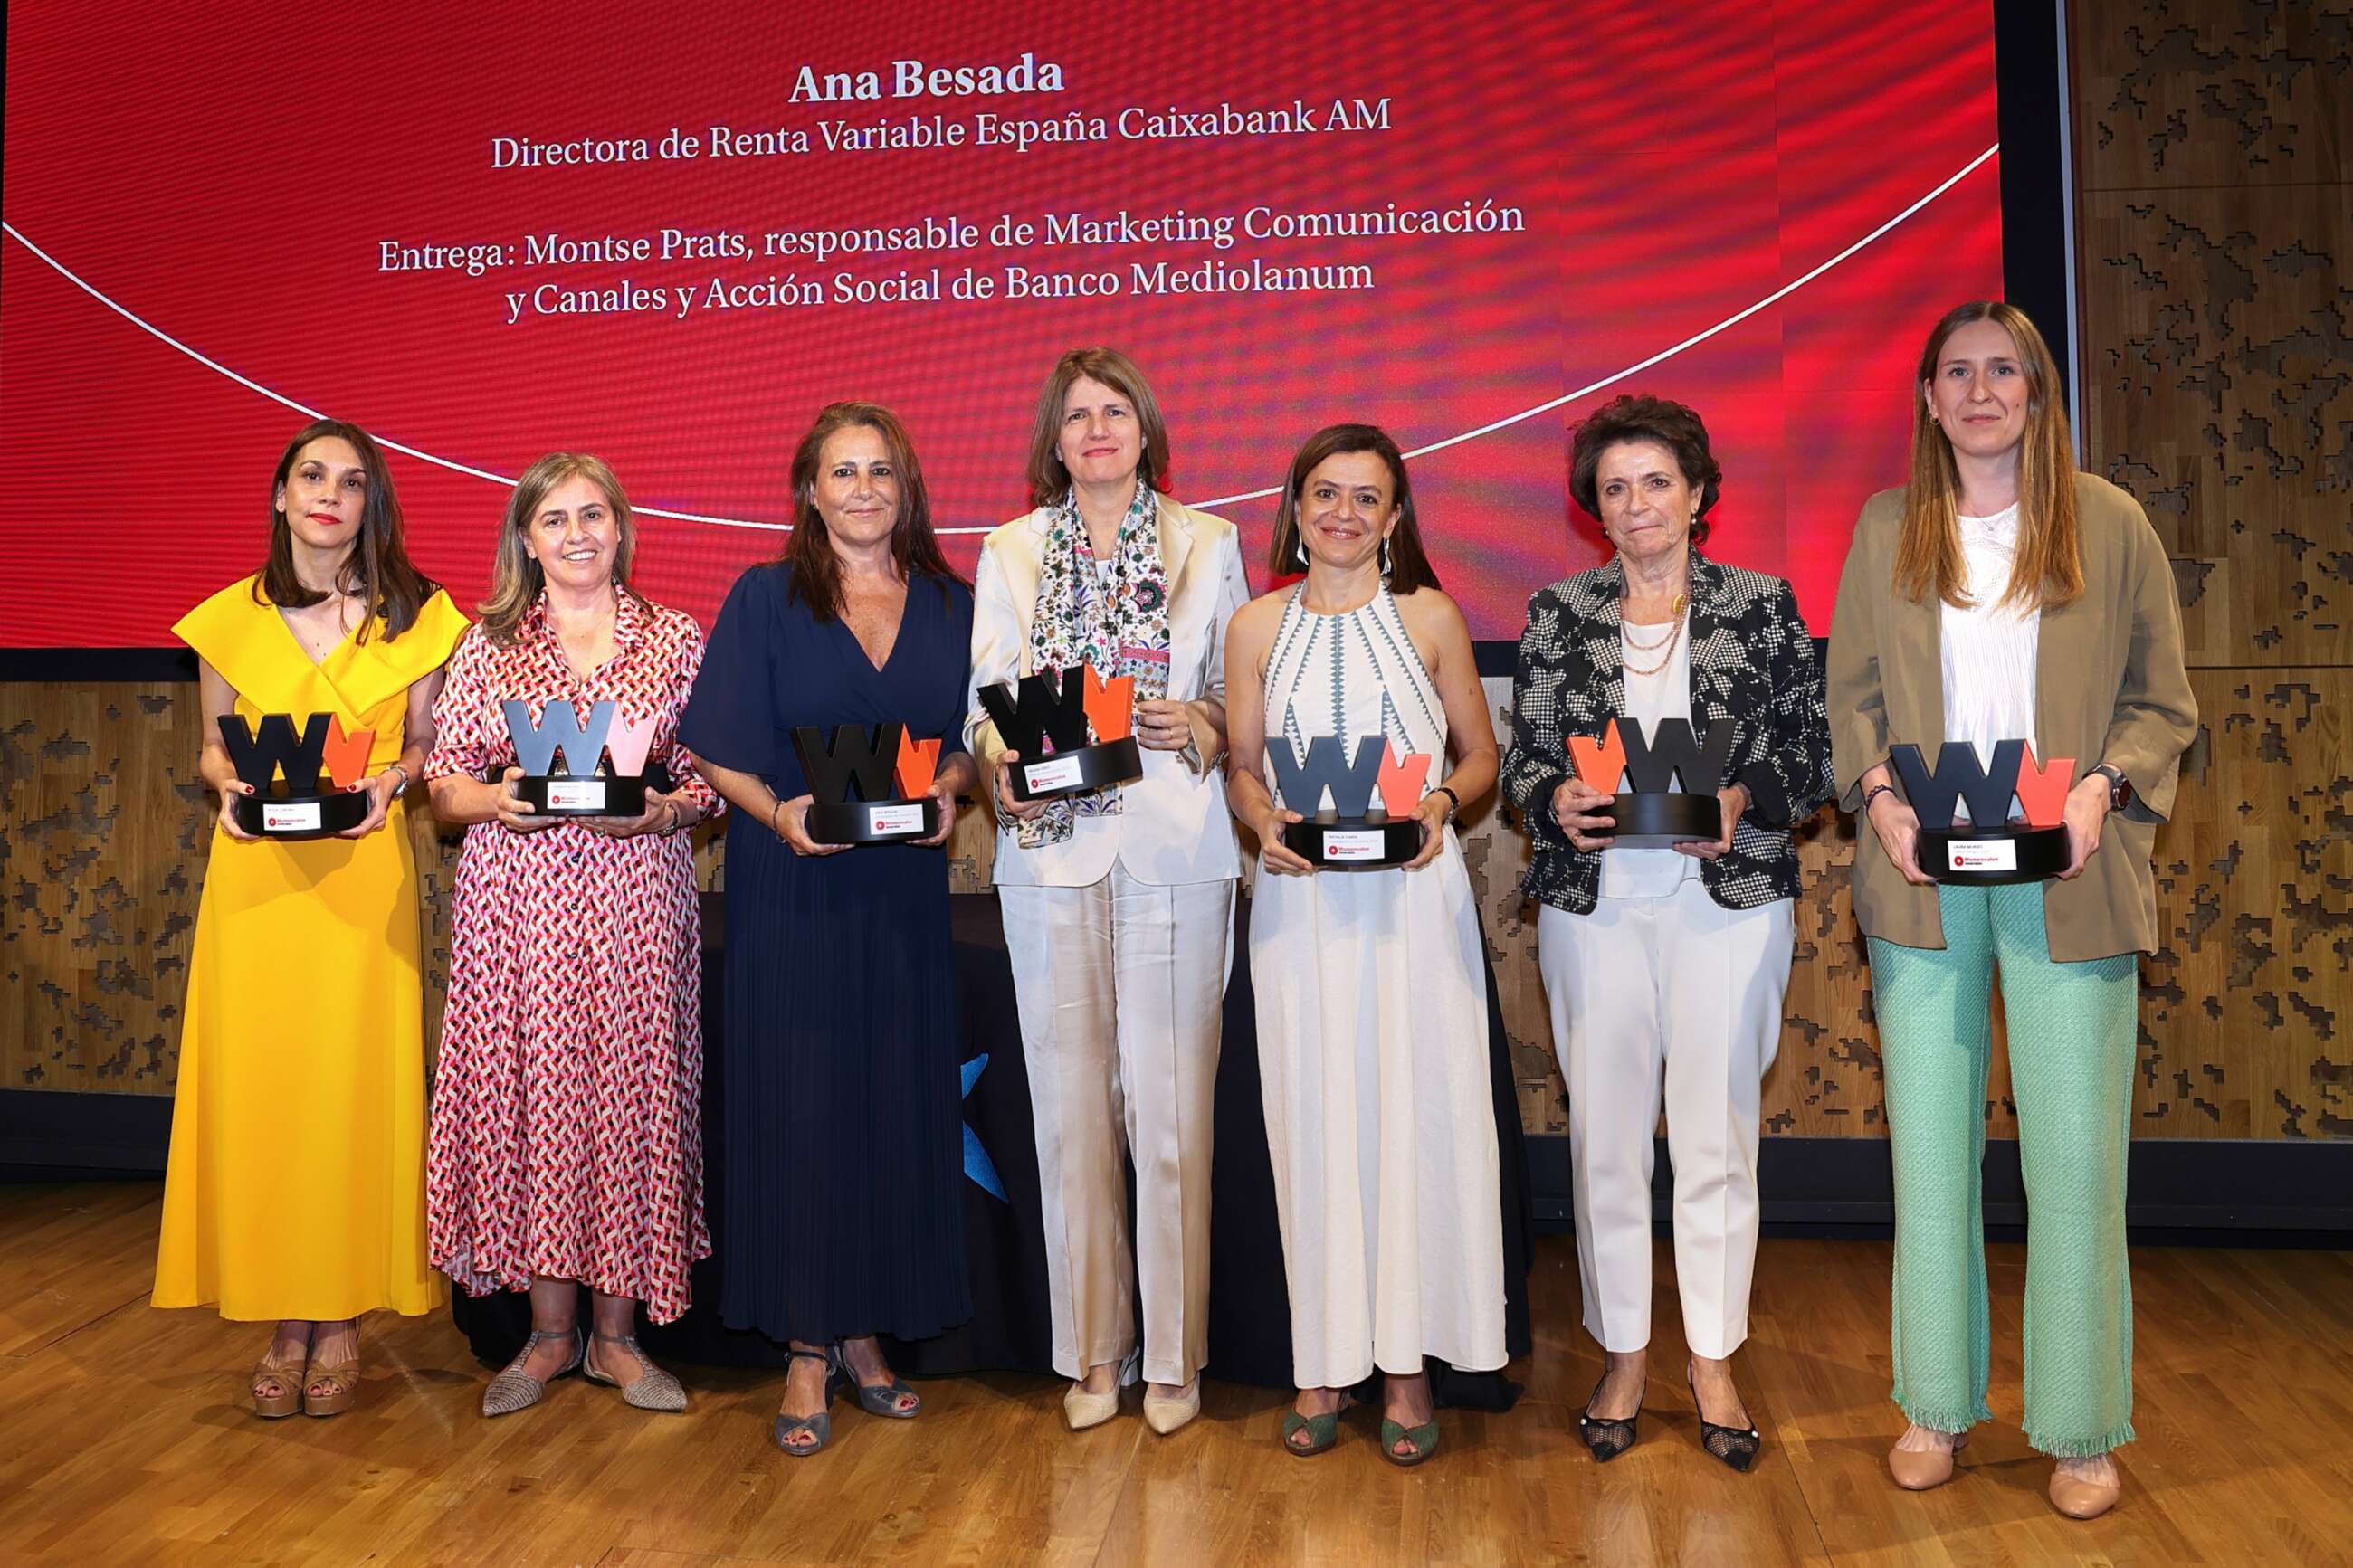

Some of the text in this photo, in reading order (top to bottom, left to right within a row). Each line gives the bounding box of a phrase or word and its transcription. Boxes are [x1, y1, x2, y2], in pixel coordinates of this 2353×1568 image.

[787, 52, 1066, 104] Ana Besada
[491, 97, 1392, 169] Directora de Renta Variable España Caixabank AM
[377, 197, 1527, 277] Entrega: Montse Prats, responsable de Marketing Comunicación
[505, 258, 1376, 325] y Canales y Acción Social de Banco Mediolanum
